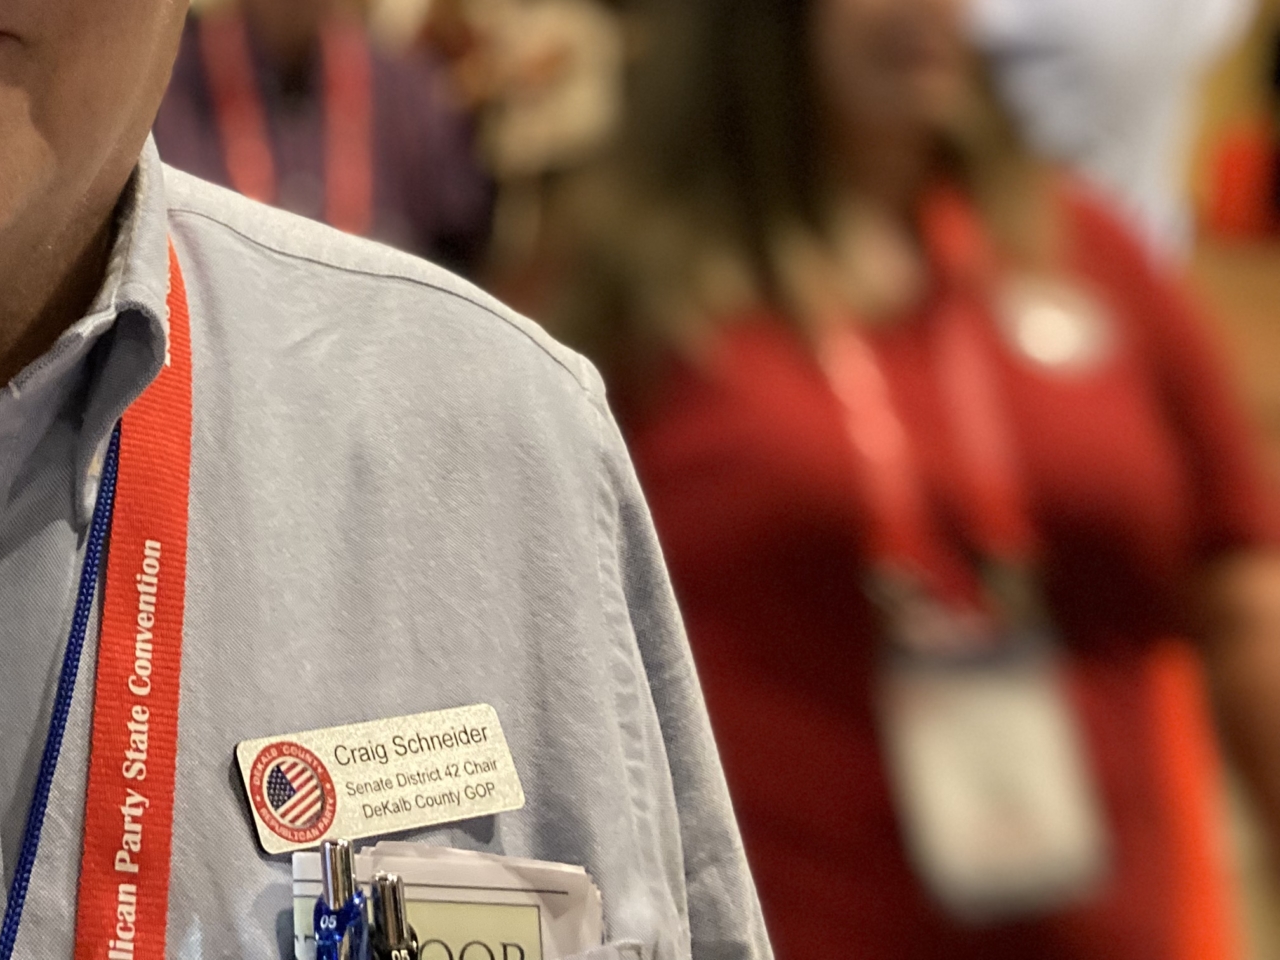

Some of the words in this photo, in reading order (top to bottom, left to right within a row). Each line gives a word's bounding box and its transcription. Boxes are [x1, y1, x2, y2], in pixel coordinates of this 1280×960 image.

[128, 540, 161, 696] Convention
[122, 705, 150, 782] State
[333, 742, 389, 766] Craig
[392, 726, 488, 756] Schneider
[252, 747, 279, 786] DEKALB
[282, 744, 324, 773] COUNTY
[345, 778, 395, 797] Senate
[395, 769, 443, 789] District
[443, 763, 462, 779] 42
[463, 759, 499, 777] Chair
[317, 796, 335, 832] PARTY
[362, 799, 413, 820] DeKalb
[414, 790, 461, 810] County
[463, 781, 496, 801] GOP
[115, 788, 150, 874] Party
